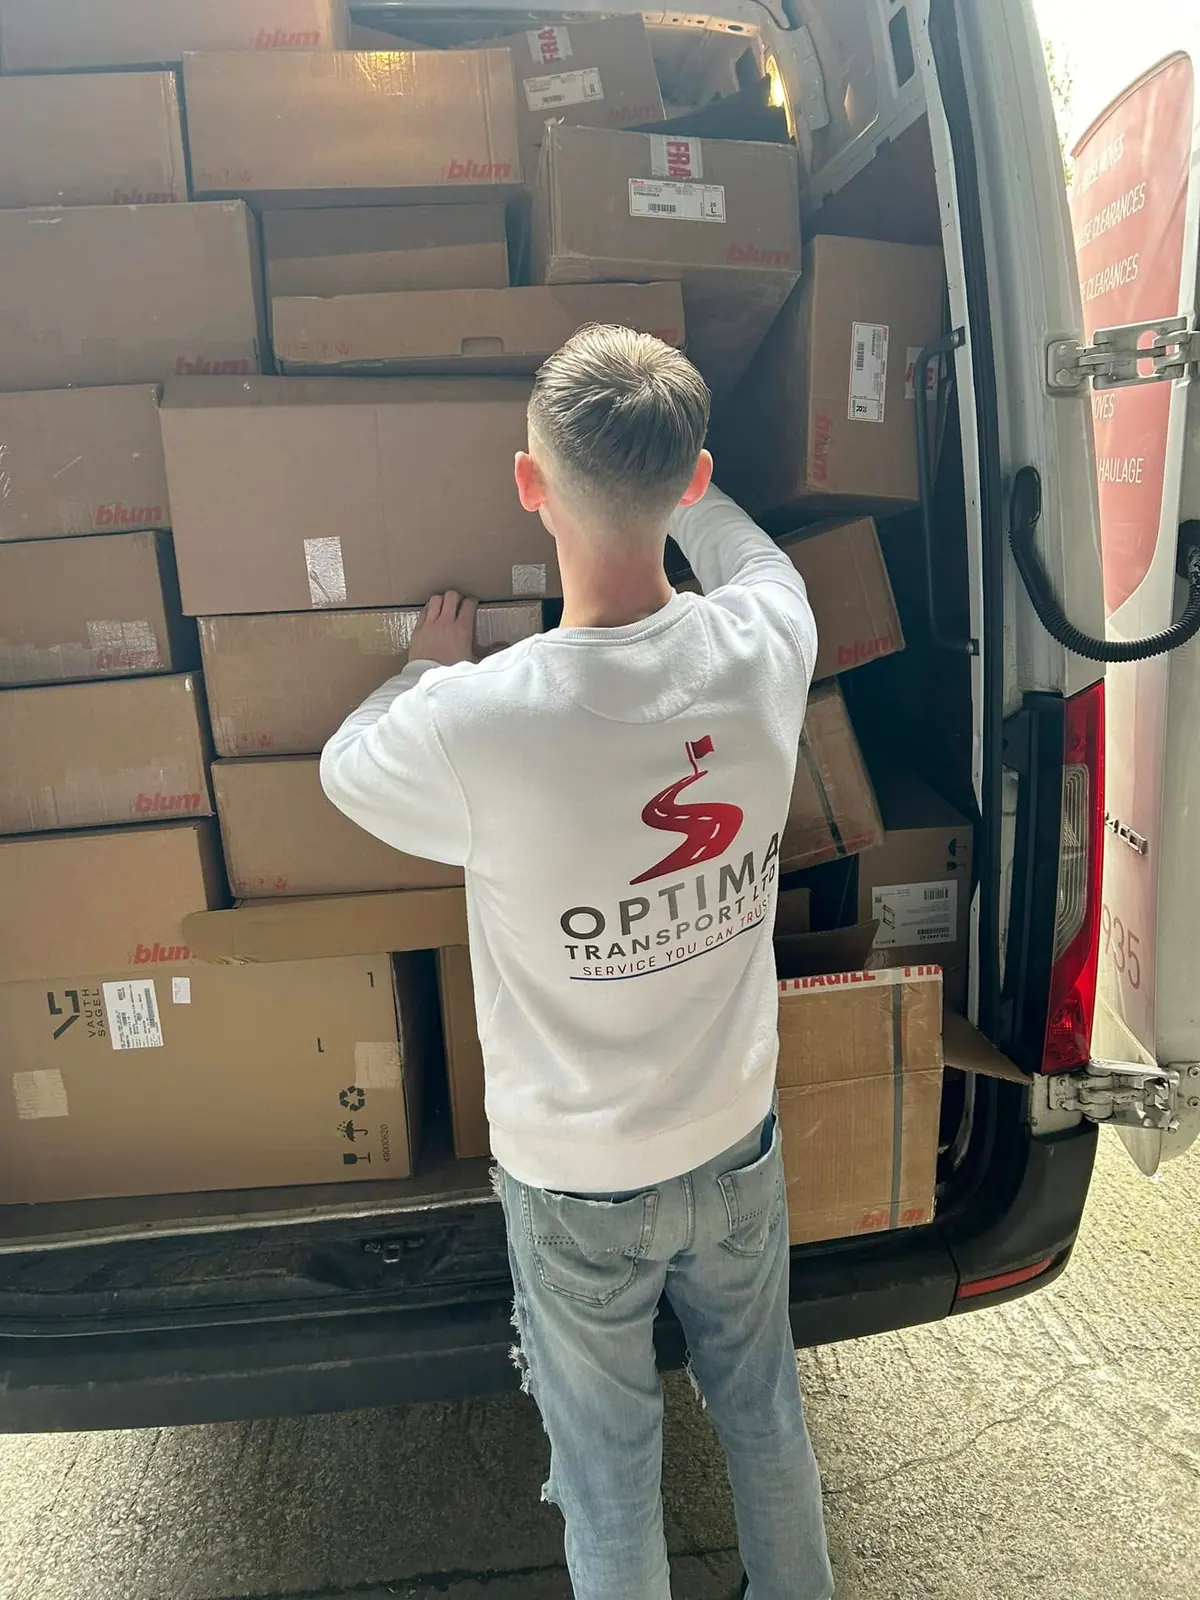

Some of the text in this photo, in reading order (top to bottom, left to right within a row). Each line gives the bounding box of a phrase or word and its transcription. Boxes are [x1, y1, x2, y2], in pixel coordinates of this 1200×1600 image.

[255, 27, 321, 52] blum
[447, 158, 511, 179] blum
[666, 141, 691, 177] FRA
[727, 242, 791, 266] blum
[1086, 253, 1139, 302] CLEARANCES
[176, 355, 249, 376] blum
[1093, 393, 1116, 420] OVES
[814, 412, 832, 481] blum
[1099, 457, 1144, 484] HAULAGE
[95, 503, 163, 525] blum
[836, 631, 896, 666] blum
[135, 792, 201, 812] blum
[560, 832, 779, 940] OPTIMA
[564, 864, 775, 960] TRANSPORT LTD
[583, 956, 656, 976] SERVICE
[665, 943, 697, 964] YOU
[705, 927, 734, 947] CAN
[81, 988, 97, 1038] VAUTH
[91, 988, 106, 1037] SAGEL
